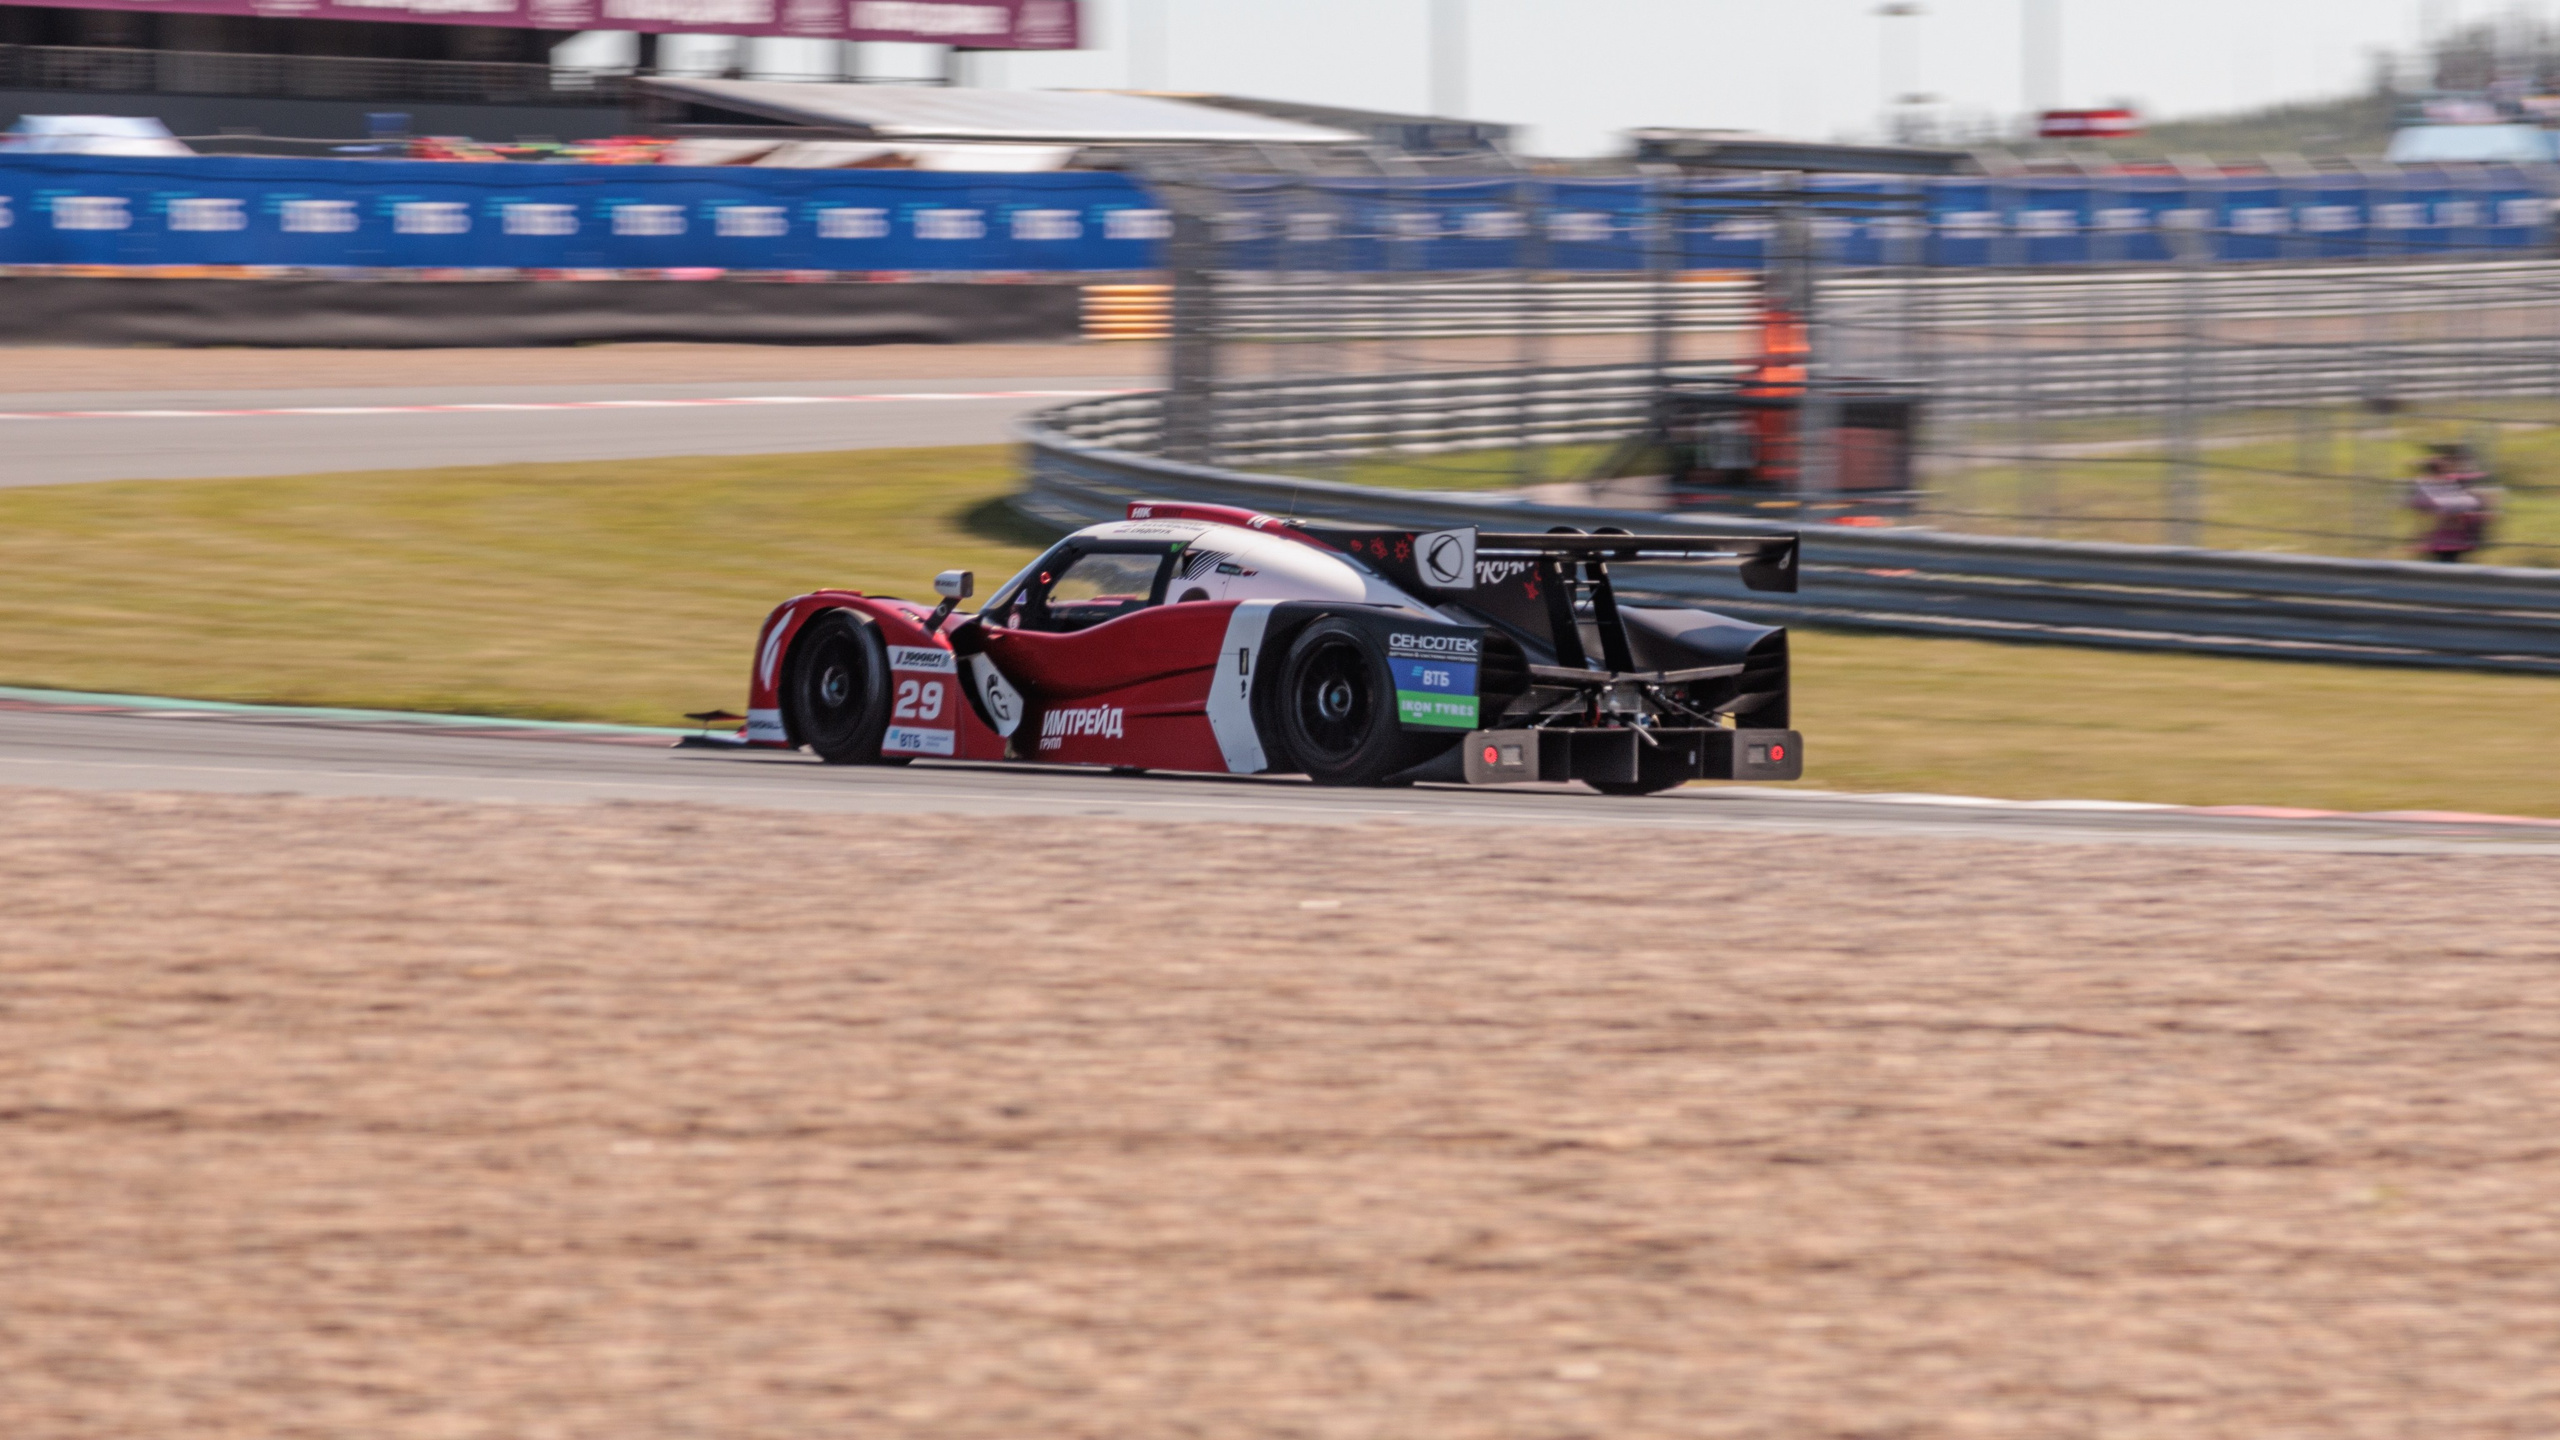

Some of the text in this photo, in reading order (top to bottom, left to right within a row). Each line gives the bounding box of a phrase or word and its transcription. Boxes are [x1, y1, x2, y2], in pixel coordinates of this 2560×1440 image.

[1389, 633, 1478, 653] СЕНСОТЕК
[1422, 669, 1451, 687] ВТБ
[894, 679, 944, 720] 29
[1402, 699, 1476, 718] IKON TYRES
[1041, 703, 1124, 739] ИМТРЕЙД
[899, 733, 921, 749] ВТБ
[1039, 736, 1063, 750] ГРУПП
